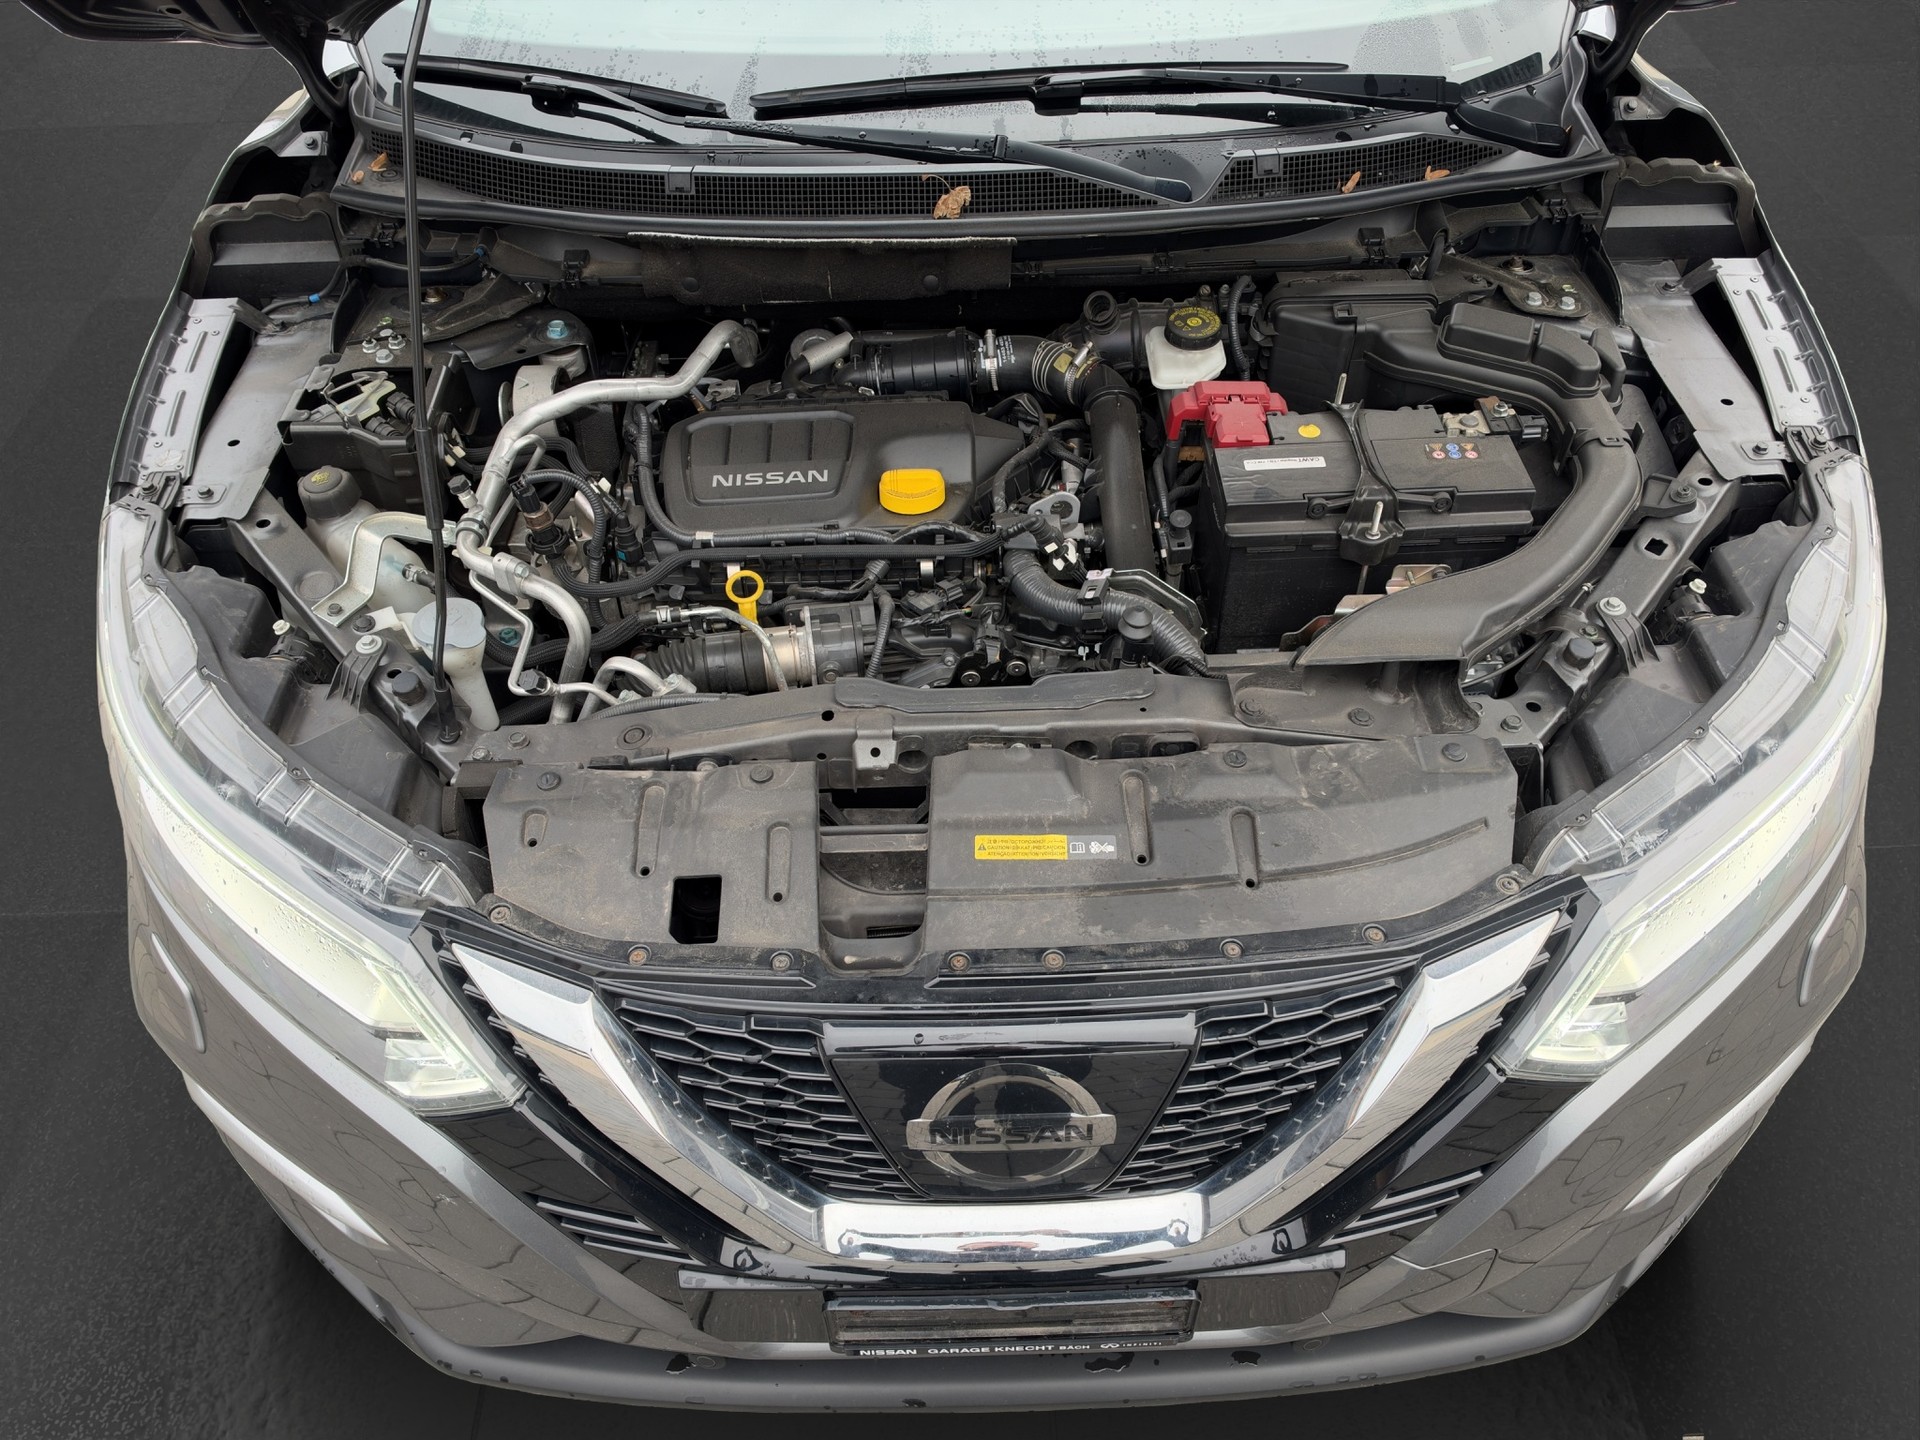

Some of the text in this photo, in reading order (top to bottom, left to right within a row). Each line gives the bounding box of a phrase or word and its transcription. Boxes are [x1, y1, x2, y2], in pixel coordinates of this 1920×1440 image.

[712, 469, 829, 488] NISSAN
[929, 1123, 1094, 1145] NISSAN
[927, 1346, 990, 1354] GARAGE
